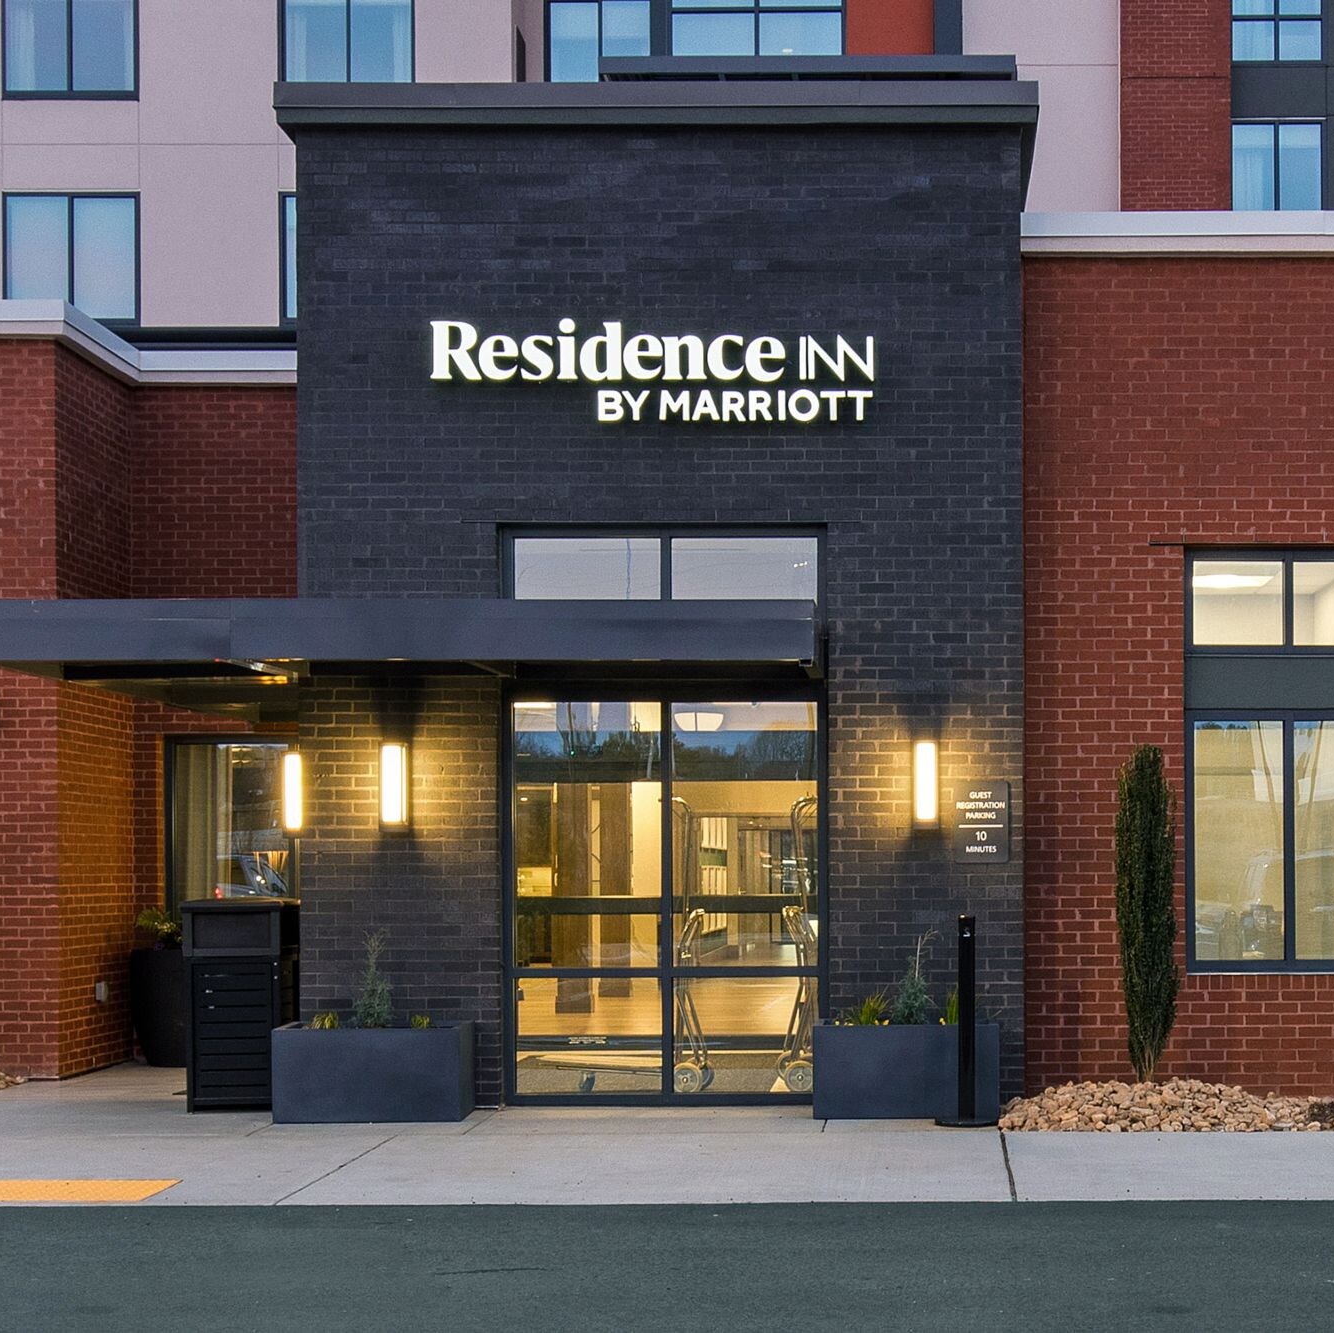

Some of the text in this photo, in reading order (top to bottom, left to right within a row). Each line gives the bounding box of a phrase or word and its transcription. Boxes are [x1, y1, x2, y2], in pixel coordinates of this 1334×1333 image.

[429, 318, 874, 382] Residence INN
[597, 390, 873, 422] BY MARRIOTT
[969, 791, 992, 799] GUEST
[975, 831, 987, 841] 10
[965, 845, 997, 853] MINUTES
